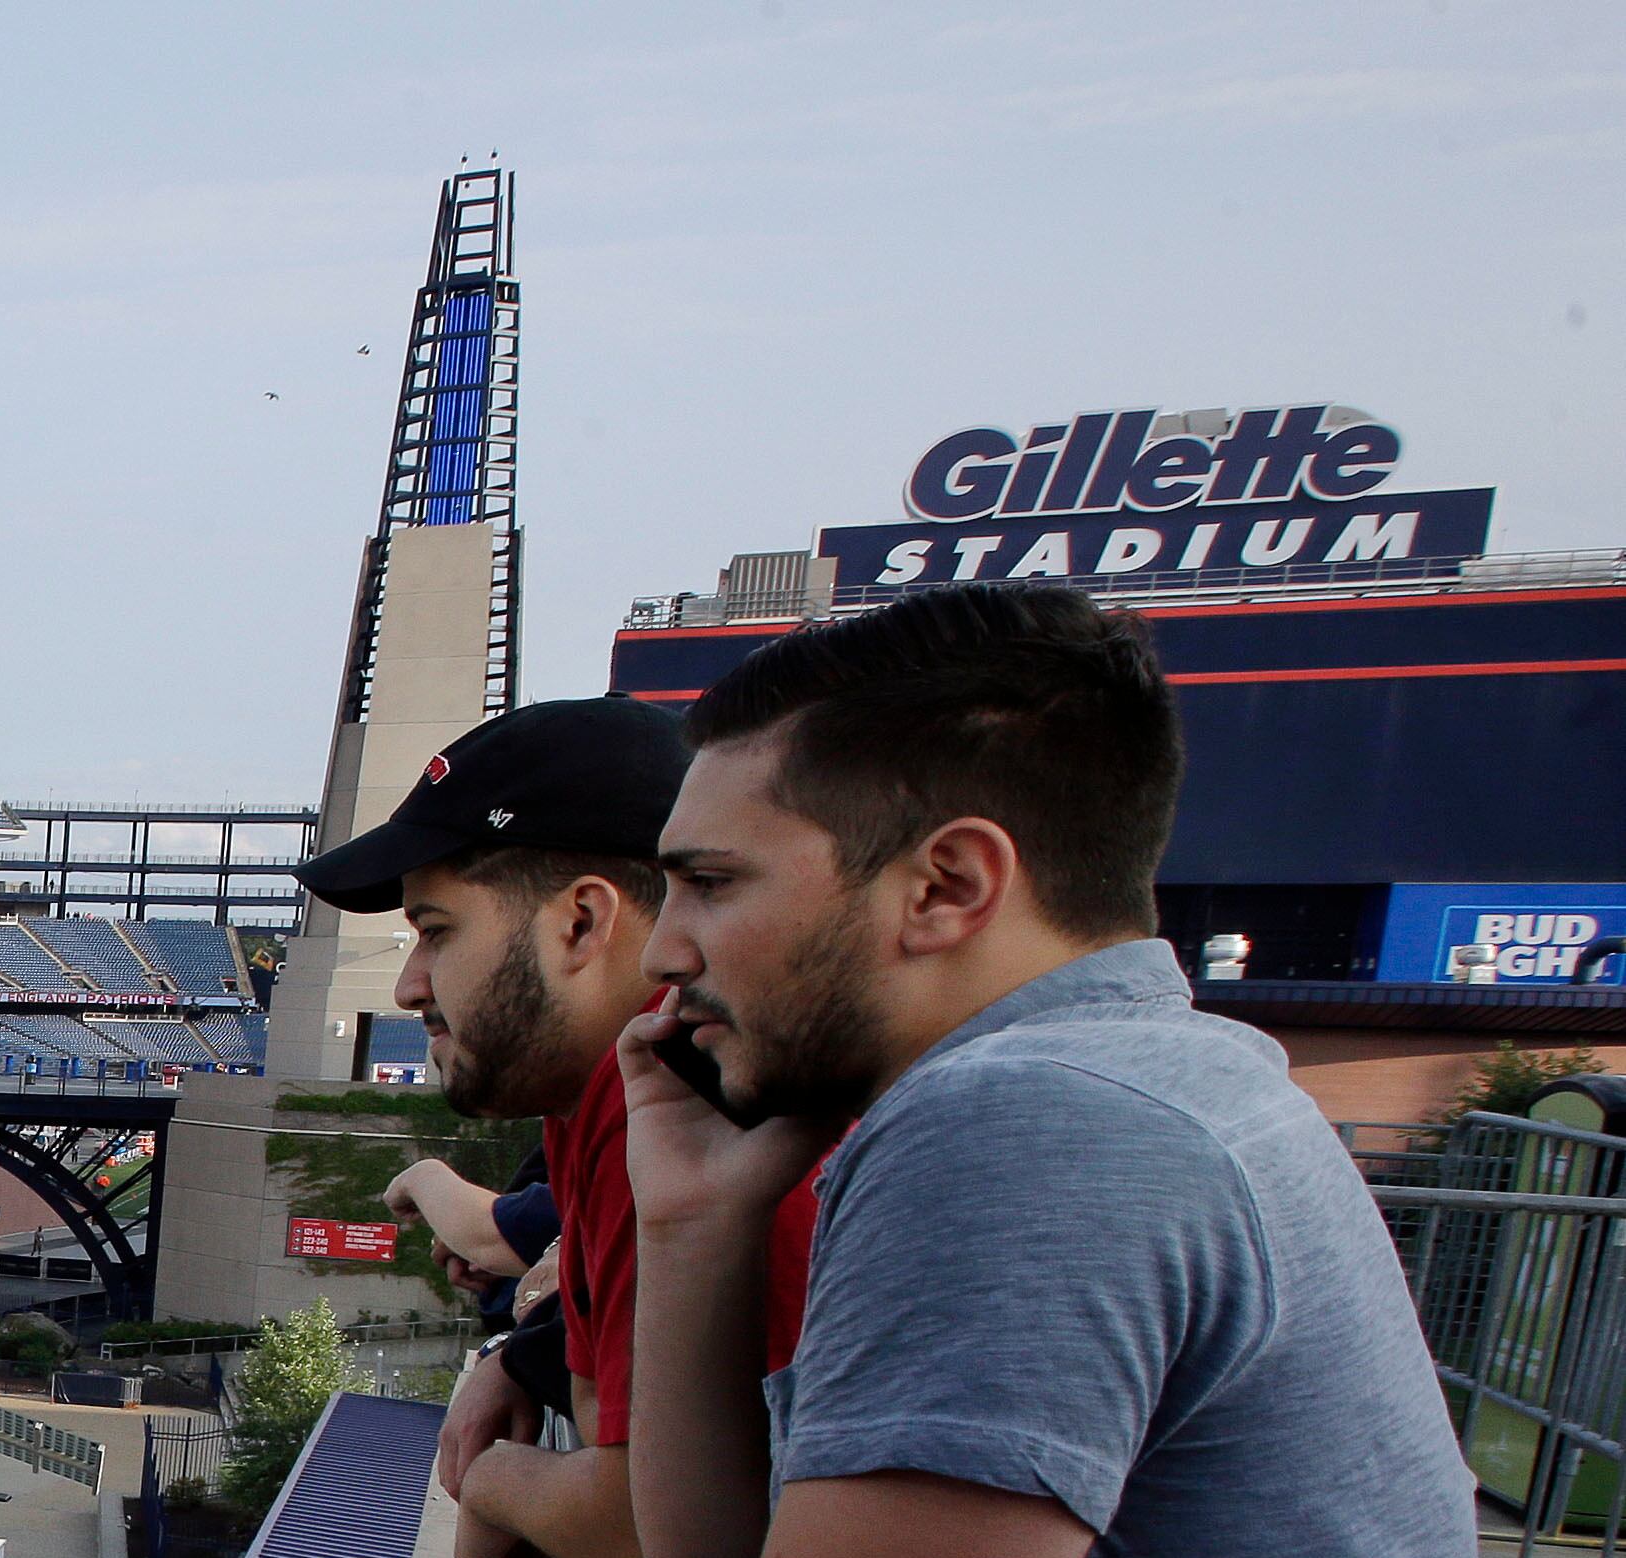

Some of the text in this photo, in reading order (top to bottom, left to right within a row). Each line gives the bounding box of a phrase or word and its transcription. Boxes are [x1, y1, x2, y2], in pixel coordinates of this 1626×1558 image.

[904, 402, 1402, 522] Gillette
[877, 511, 1420, 586] STADIUM
[1474, 914, 1598, 945] BUD
